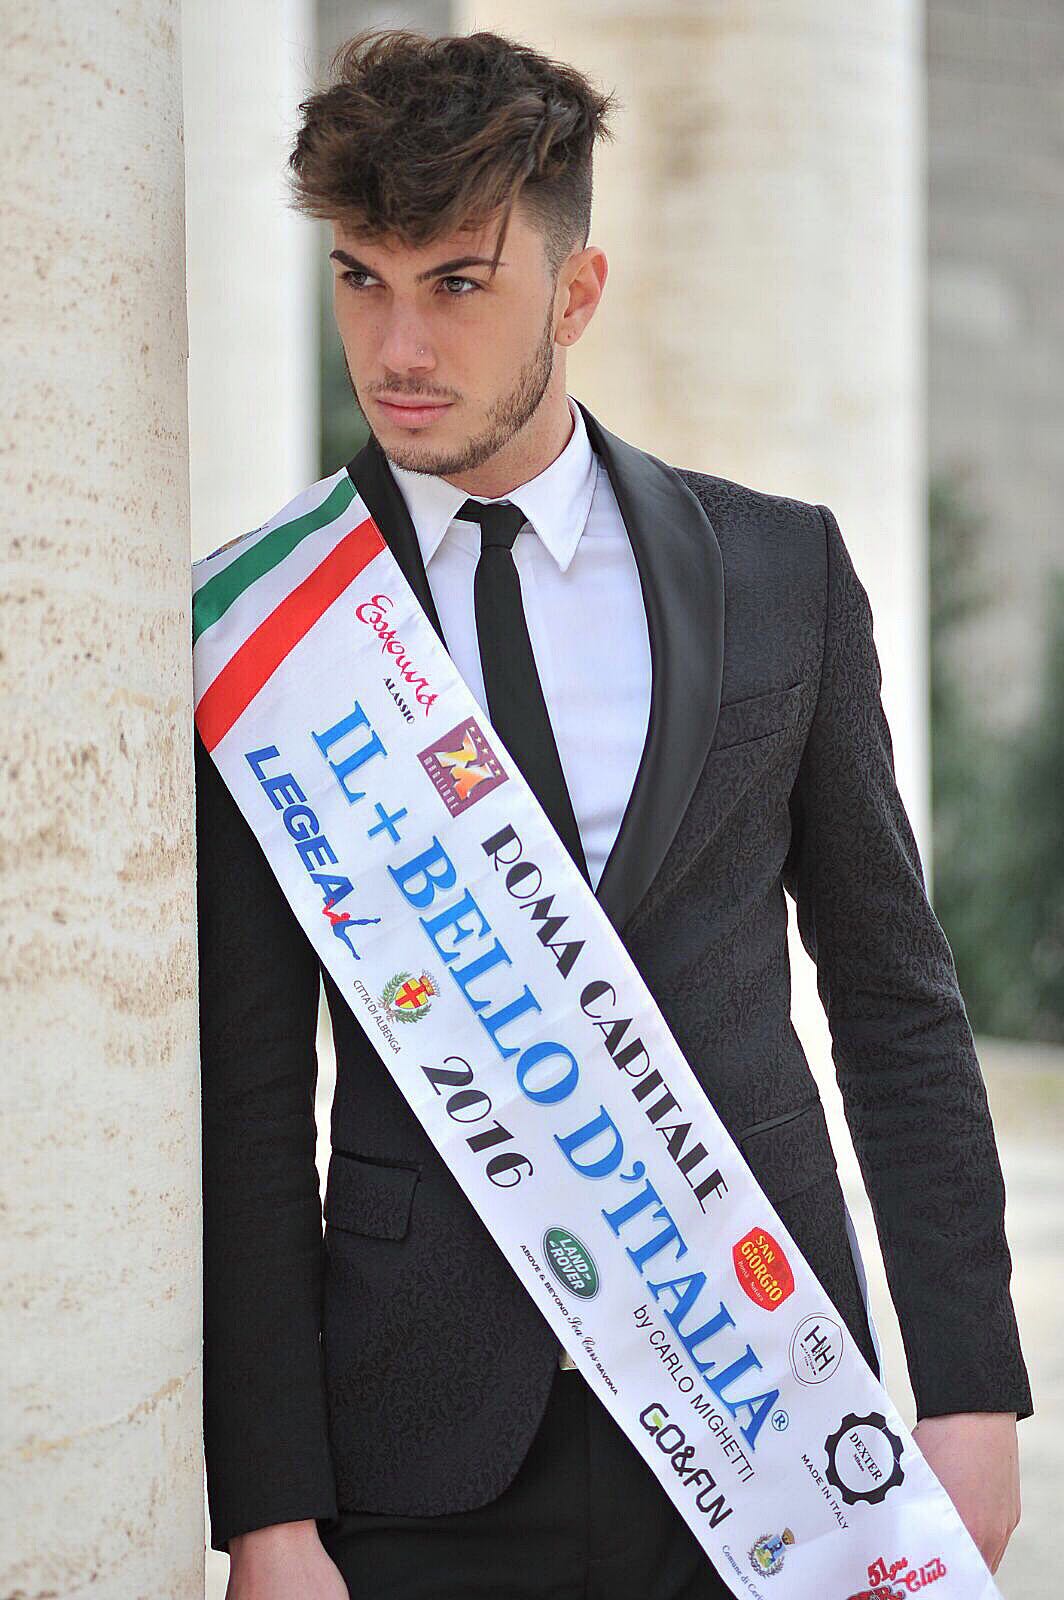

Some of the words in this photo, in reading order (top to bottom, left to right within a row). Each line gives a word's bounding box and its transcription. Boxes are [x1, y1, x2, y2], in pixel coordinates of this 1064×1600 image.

[382, 677, 415, 725] ALASSIO
[244, 745, 354, 909] LEGEA
[311, 700, 388, 805] IL
[387, 835, 579, 1104] BELLO
[366, 1003, 379, 1017] DI
[373, 1015, 401, 1055] ALBENGA
[481, 823, 586, 980] ROMA
[580, 980, 729, 1214] CAPITALE
[420, 1056, 533, 1188] 2016
[550, 1247, 586, 1290] ROVER
[559, 1238, 589, 1273] LAND
[755, 1235, 775, 1263] SAN
[520, 1244, 541, 1273] ABOVE
[544, 1281, 569, 1317] BEYOND
[596, 1362, 618, 1396] SAVONA
[633, 1304, 654, 1329] by
[649, 1330, 694, 1393] CARLO
[690, 1394, 755, 1483] MIGHETTI
[639, 1403, 734, 1529] GO&FUN
[801, 1454, 824, 1486] MADE
[821, 1486, 832, 1499] IN
[829, 1500, 849, 1530] ITALY
[849, 1432, 883, 1481] DEXTER
[722, 1544, 743, 1575] Comune
[741, 1575, 751, 1585] di
